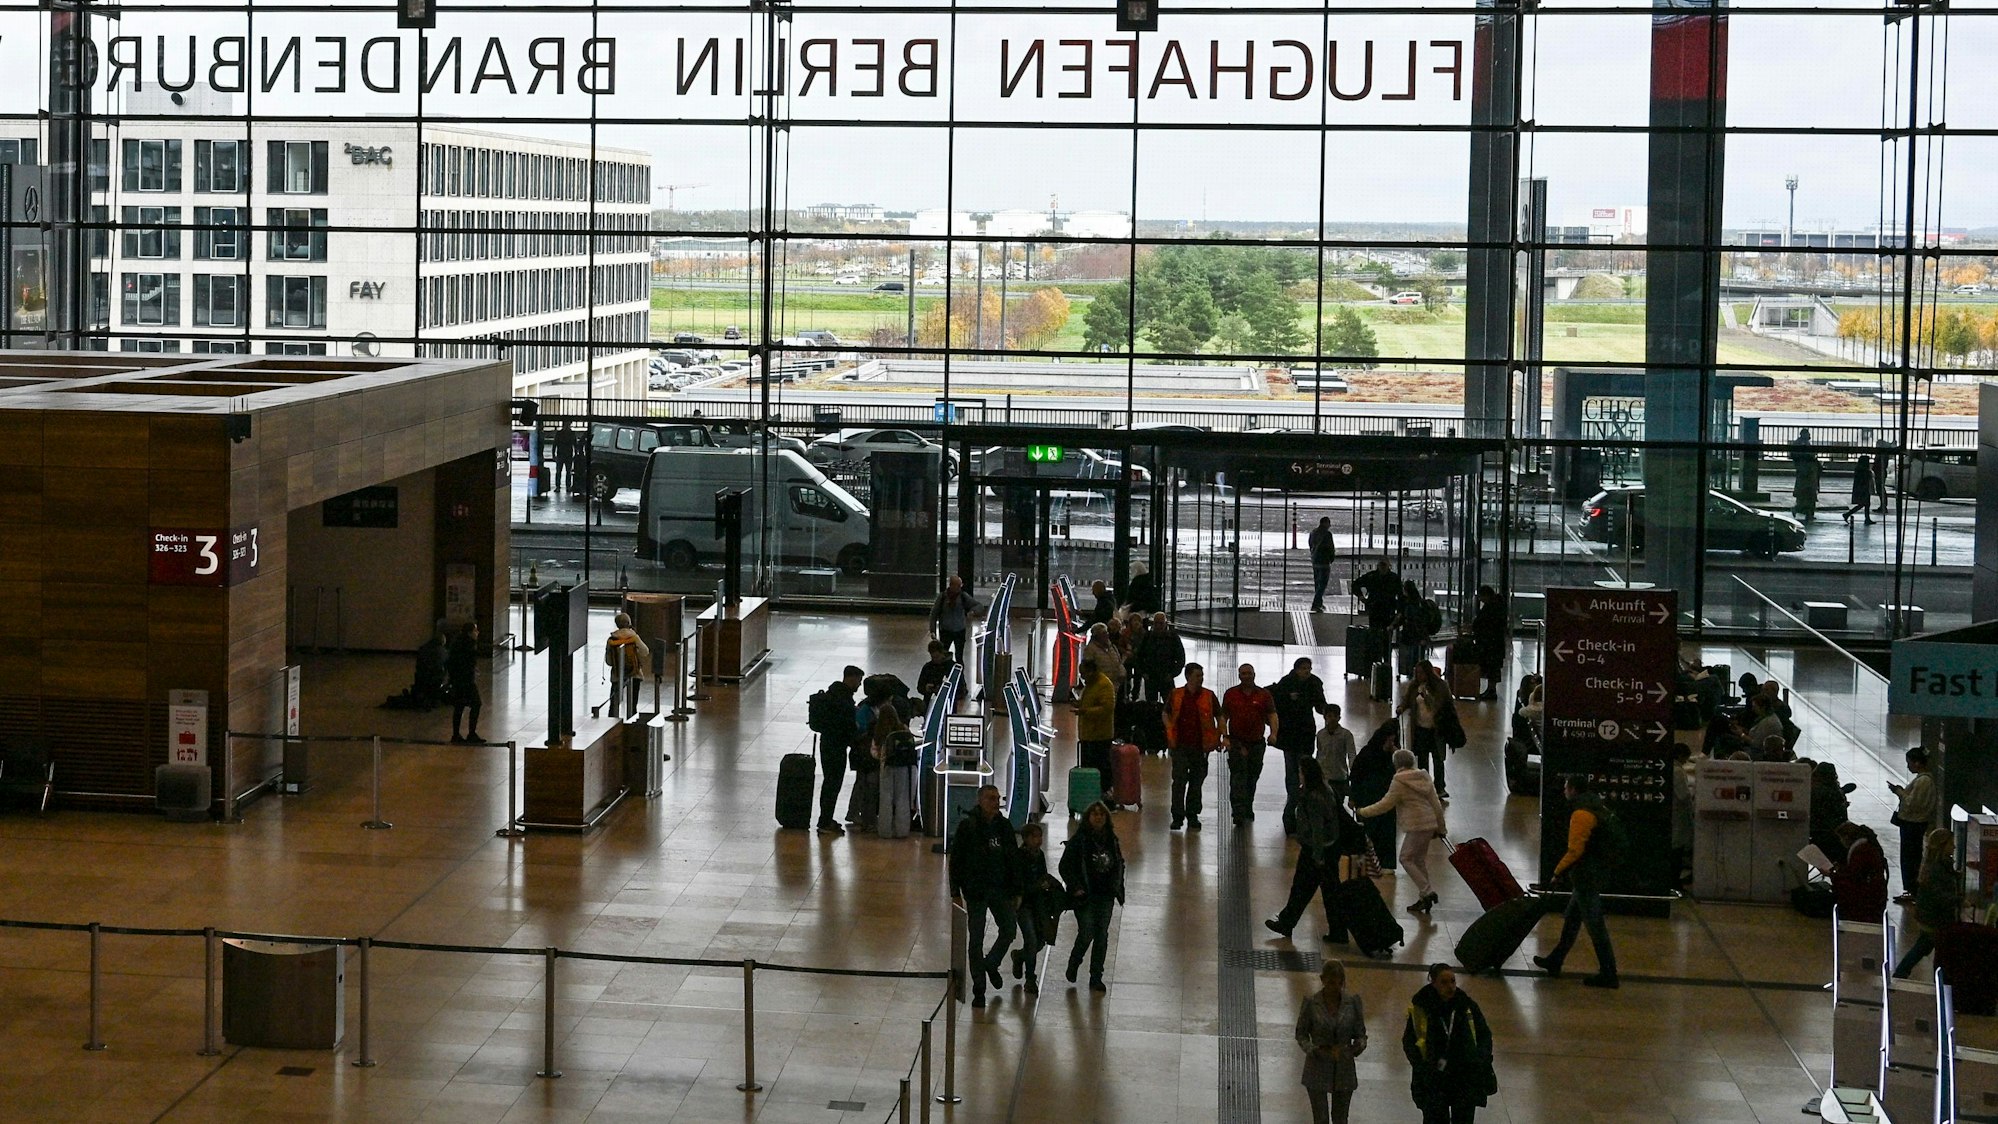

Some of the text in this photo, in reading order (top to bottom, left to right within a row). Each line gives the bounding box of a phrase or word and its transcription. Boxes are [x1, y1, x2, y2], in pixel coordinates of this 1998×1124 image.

[349, 281, 386, 299] FAY
[1585, 399, 1642, 420] CHEC
[155, 533, 189, 543] Check-in
[250, 528, 258, 567] 3
[194, 535, 219, 575] 3
[1589, 598, 1646, 612] Ankunft
[1612, 614, 1646, 624] Arrival
[1577, 639, 1636, 652] Check-in
[1585, 677, 1644, 690] Check-in
[1910, 666, 1983, 697] Fast
[1552, 717, 1596, 729] Terminal
